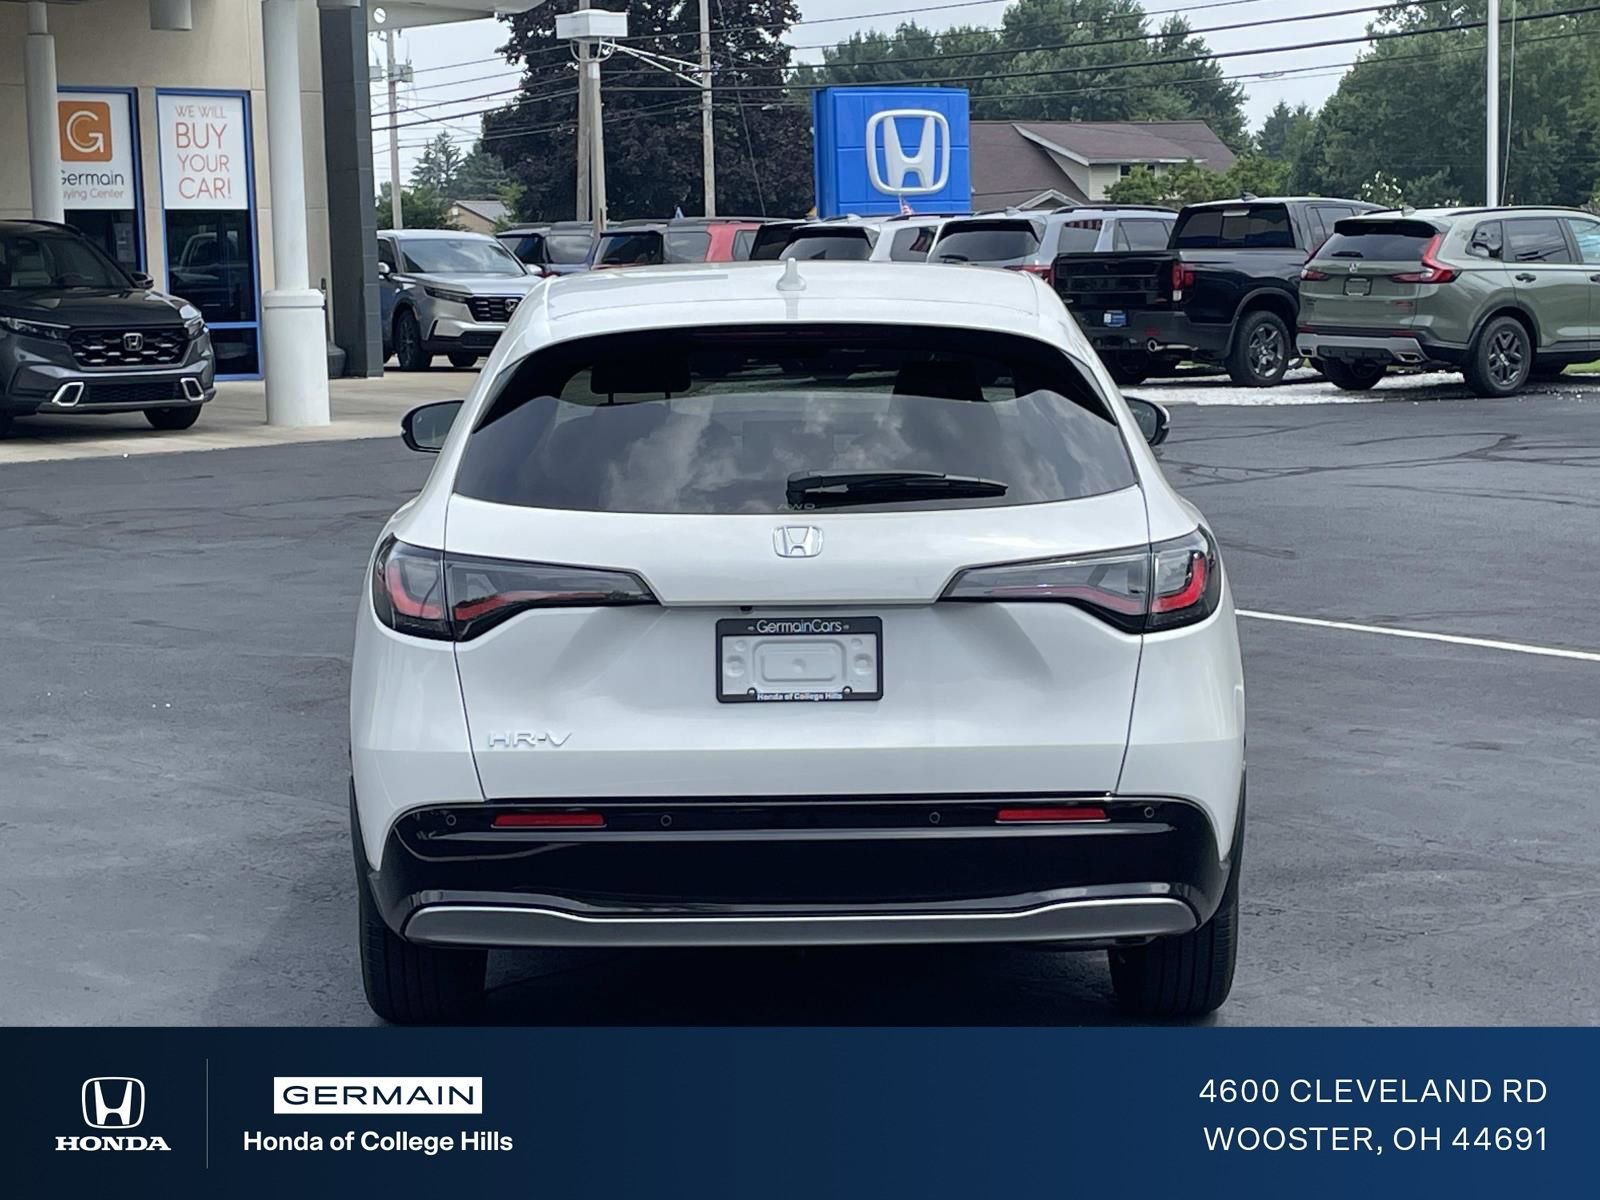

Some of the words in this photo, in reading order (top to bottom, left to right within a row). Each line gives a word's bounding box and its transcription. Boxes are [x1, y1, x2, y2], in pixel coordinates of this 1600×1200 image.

[175, 105, 195, 118] WE
[198, 105, 227, 119] WILL
[175, 121, 228, 149] BUY
[177, 153, 230, 173] YOUR
[89, 187, 124, 199] Center
[178, 176, 231, 199] CAR!
[756, 619, 842, 633] GermainCars
[757, 692, 784, 701] Honda
[794, 692, 824, 702] College
[488, 730, 573, 747] HR-V
